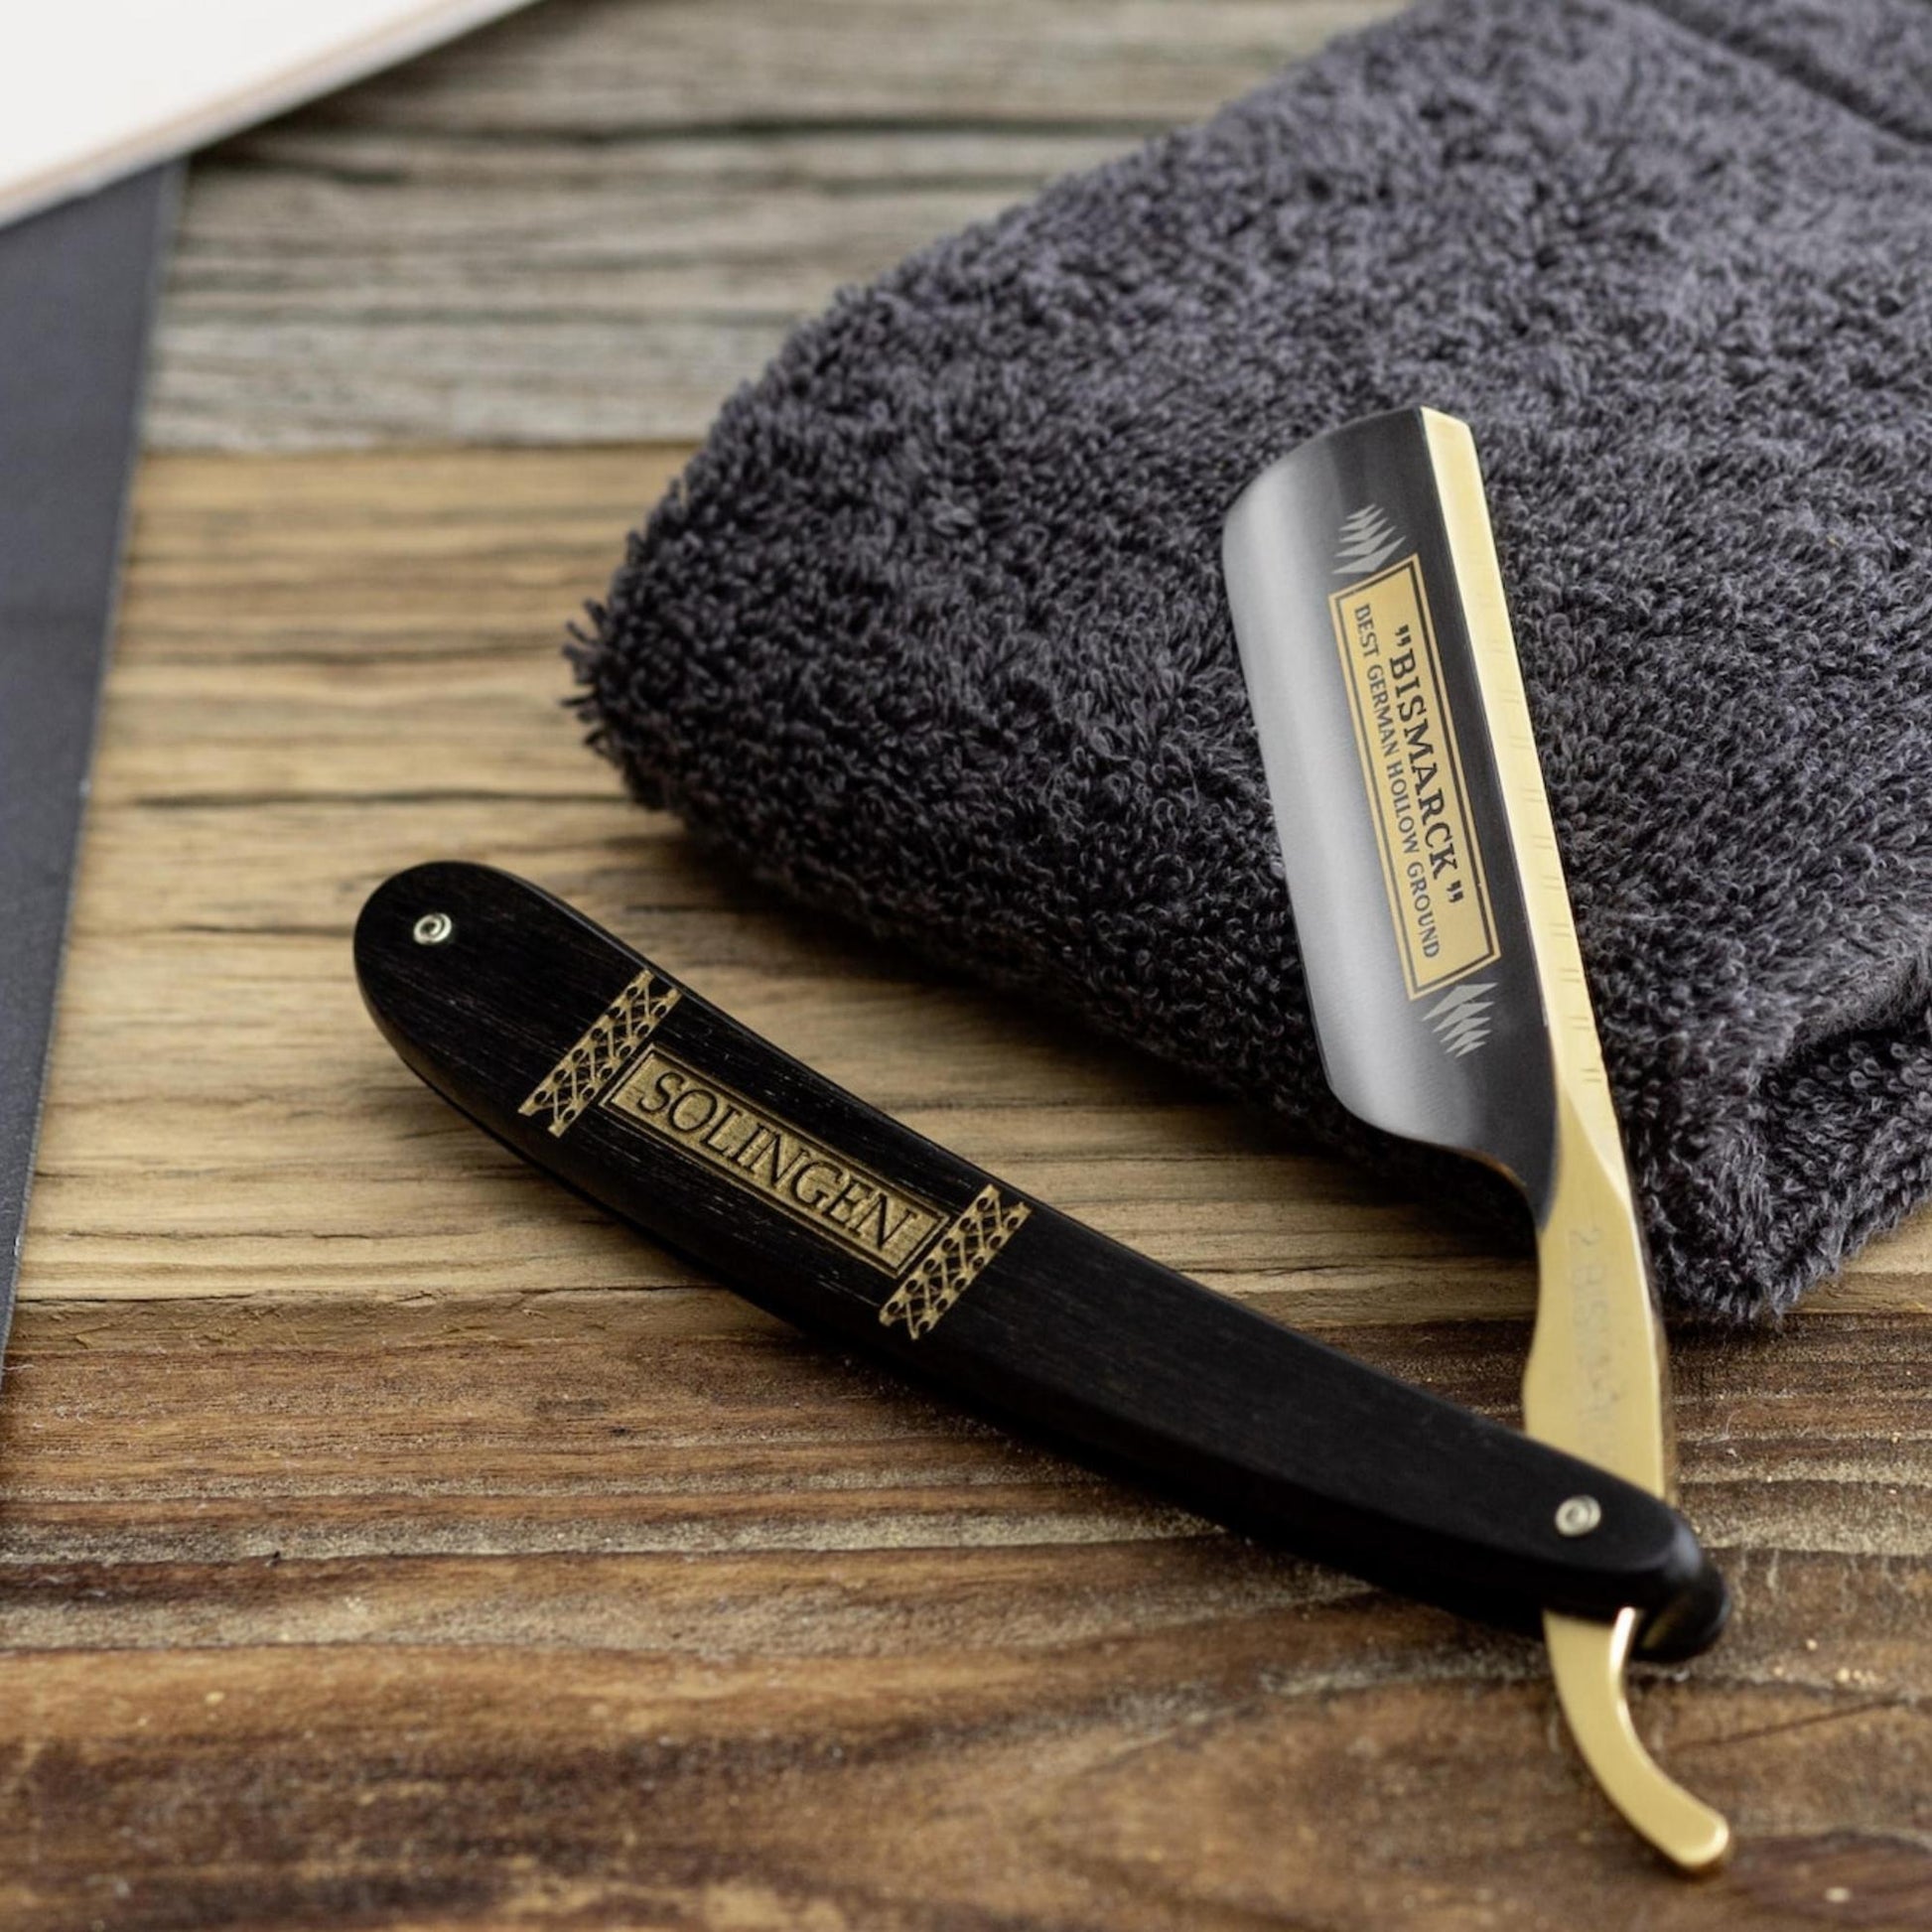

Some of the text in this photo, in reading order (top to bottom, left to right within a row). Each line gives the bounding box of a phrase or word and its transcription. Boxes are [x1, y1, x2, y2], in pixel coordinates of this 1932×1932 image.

[1354, 604, 1440, 958] BEST GERMAN HOLLOW GROUND
[637, 1071, 918, 1252] SOLINGEN
